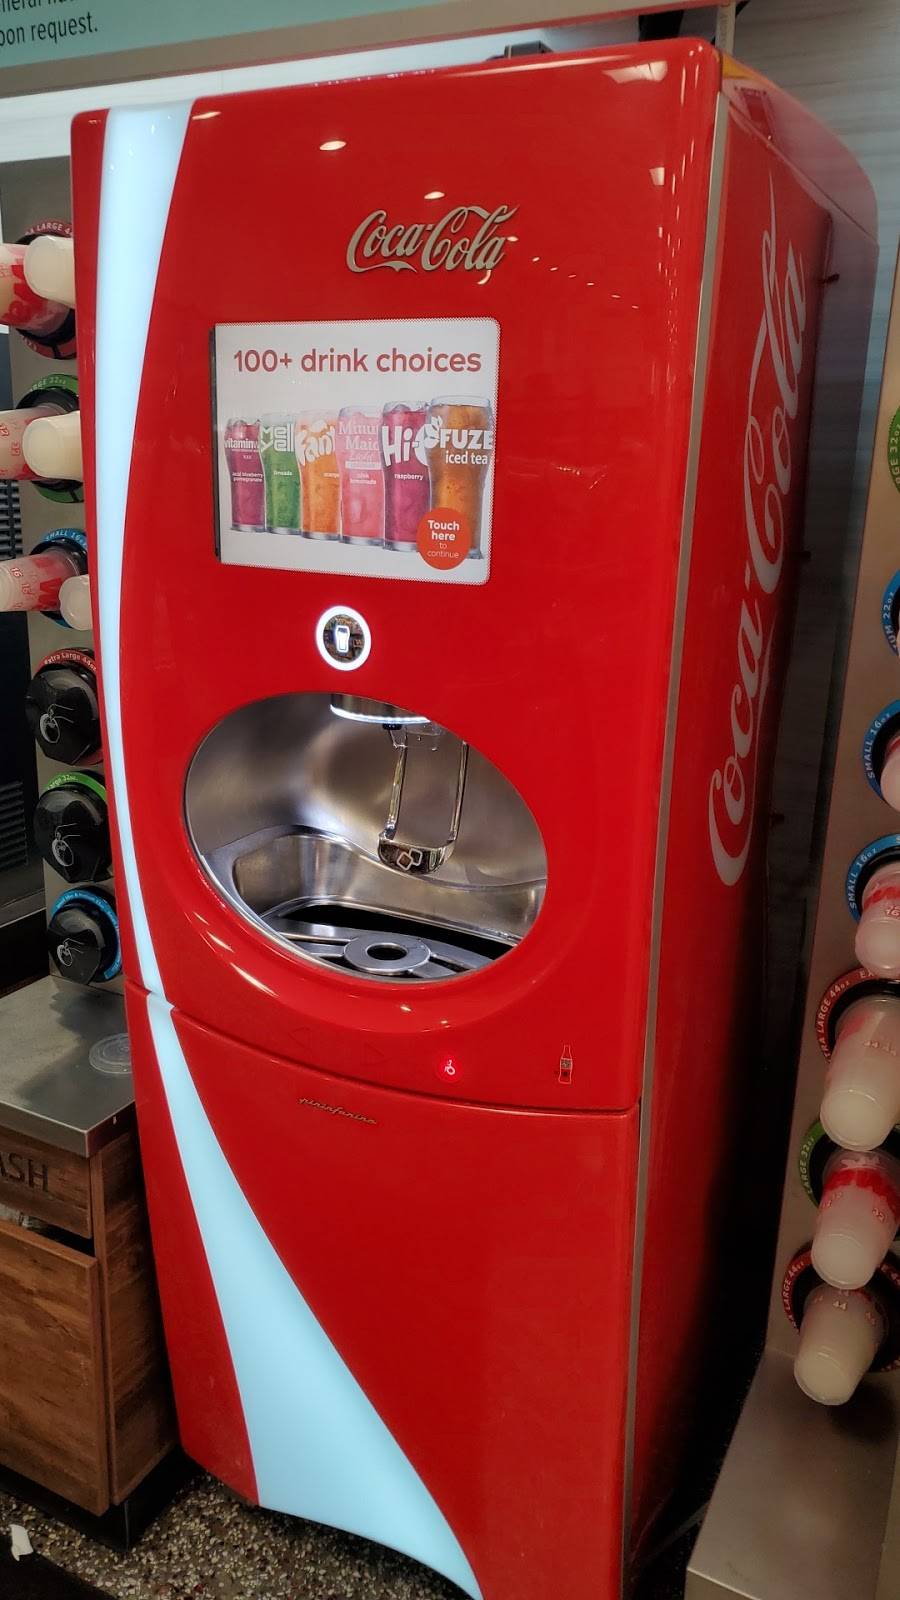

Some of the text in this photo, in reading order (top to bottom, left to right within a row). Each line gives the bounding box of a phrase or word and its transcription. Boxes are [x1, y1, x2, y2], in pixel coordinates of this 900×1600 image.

[31, 12, 98, 43] request.
[346, 204, 520, 273] Coca-Cola
[233, 347, 482, 373] 100+ drink choices
[440, 428, 494, 450] FUZE
[445, 450, 488, 465] iced tea
[394, 473, 424, 481] raspberry
[427, 519, 460, 531] Touch
[431, 530, 456, 541] here
[708, 168, 806, 886] Coca-Cola
[427, 550, 460, 559] continue
[439, 542, 448, 550] to
[864, 713, 891, 779] SMALL 16oz
[848, 848, 877, 910] SMALL 16oz
[818, 999, 832, 1034] LARGE
[0, 1152, 48, 1193] SH
